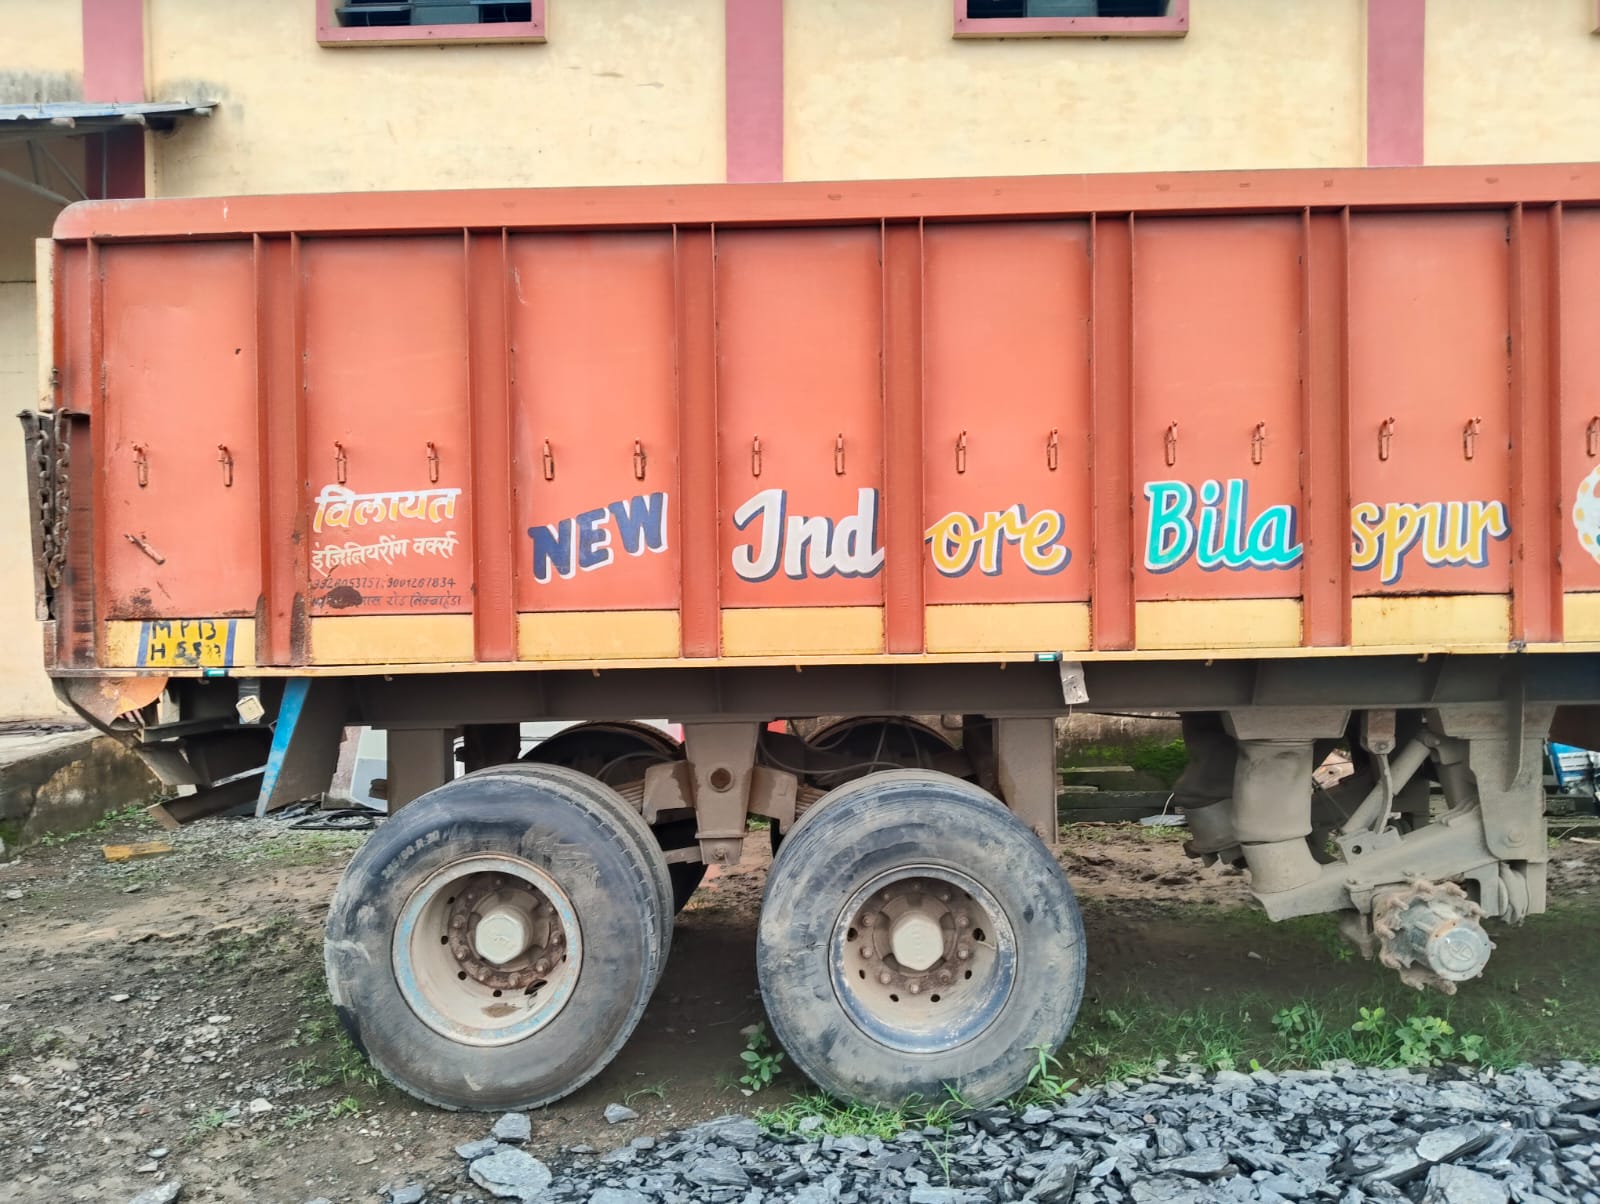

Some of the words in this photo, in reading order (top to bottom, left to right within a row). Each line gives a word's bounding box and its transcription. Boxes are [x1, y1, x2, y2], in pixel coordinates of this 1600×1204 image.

[313, 484, 462, 533] विलायत
[528, 491, 668, 584] NEW
[924, 503, 1073, 577] ore
[1143, 479, 1303, 576] Bila
[1350, 500, 1513, 586] spur
